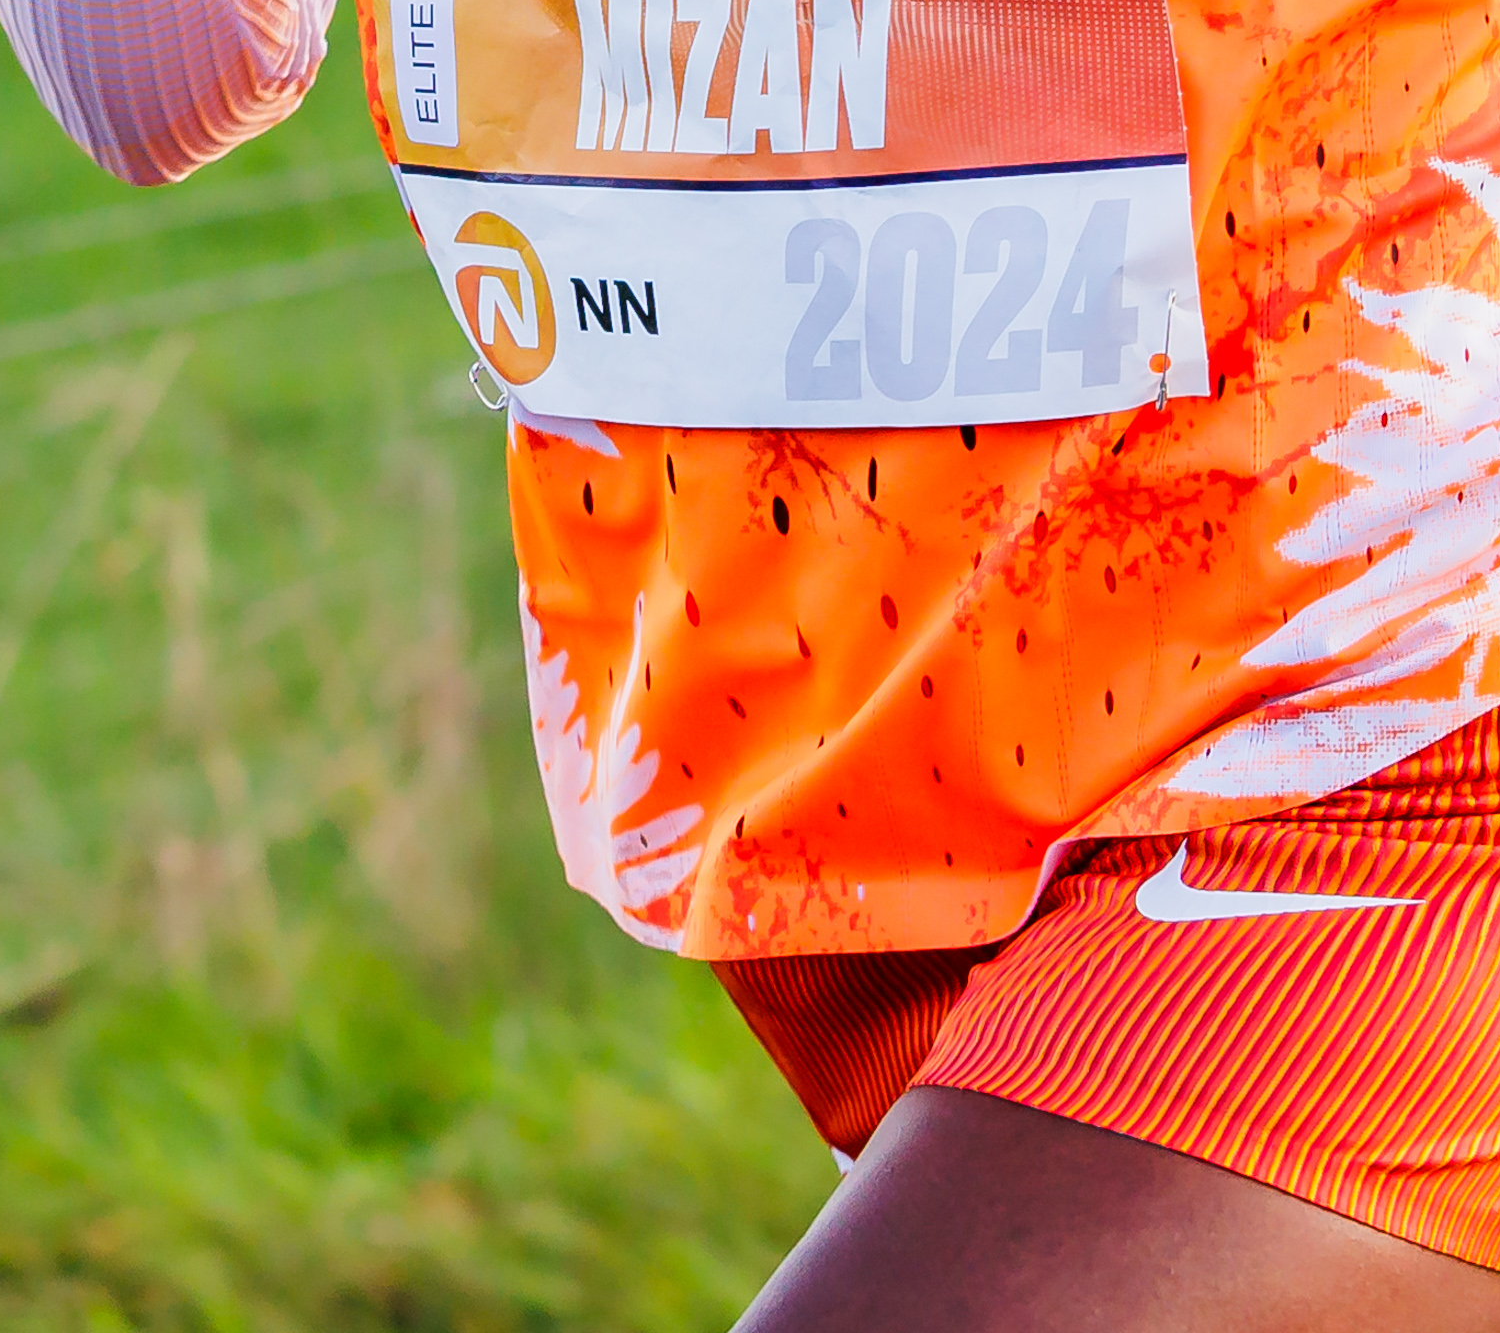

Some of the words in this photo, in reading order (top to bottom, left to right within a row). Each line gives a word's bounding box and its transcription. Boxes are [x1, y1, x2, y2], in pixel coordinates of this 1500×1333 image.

[415, 1, 440, 125] ELITE
[570, 277, 660, 335] NN
[784, 198, 1139, 402] 2024
